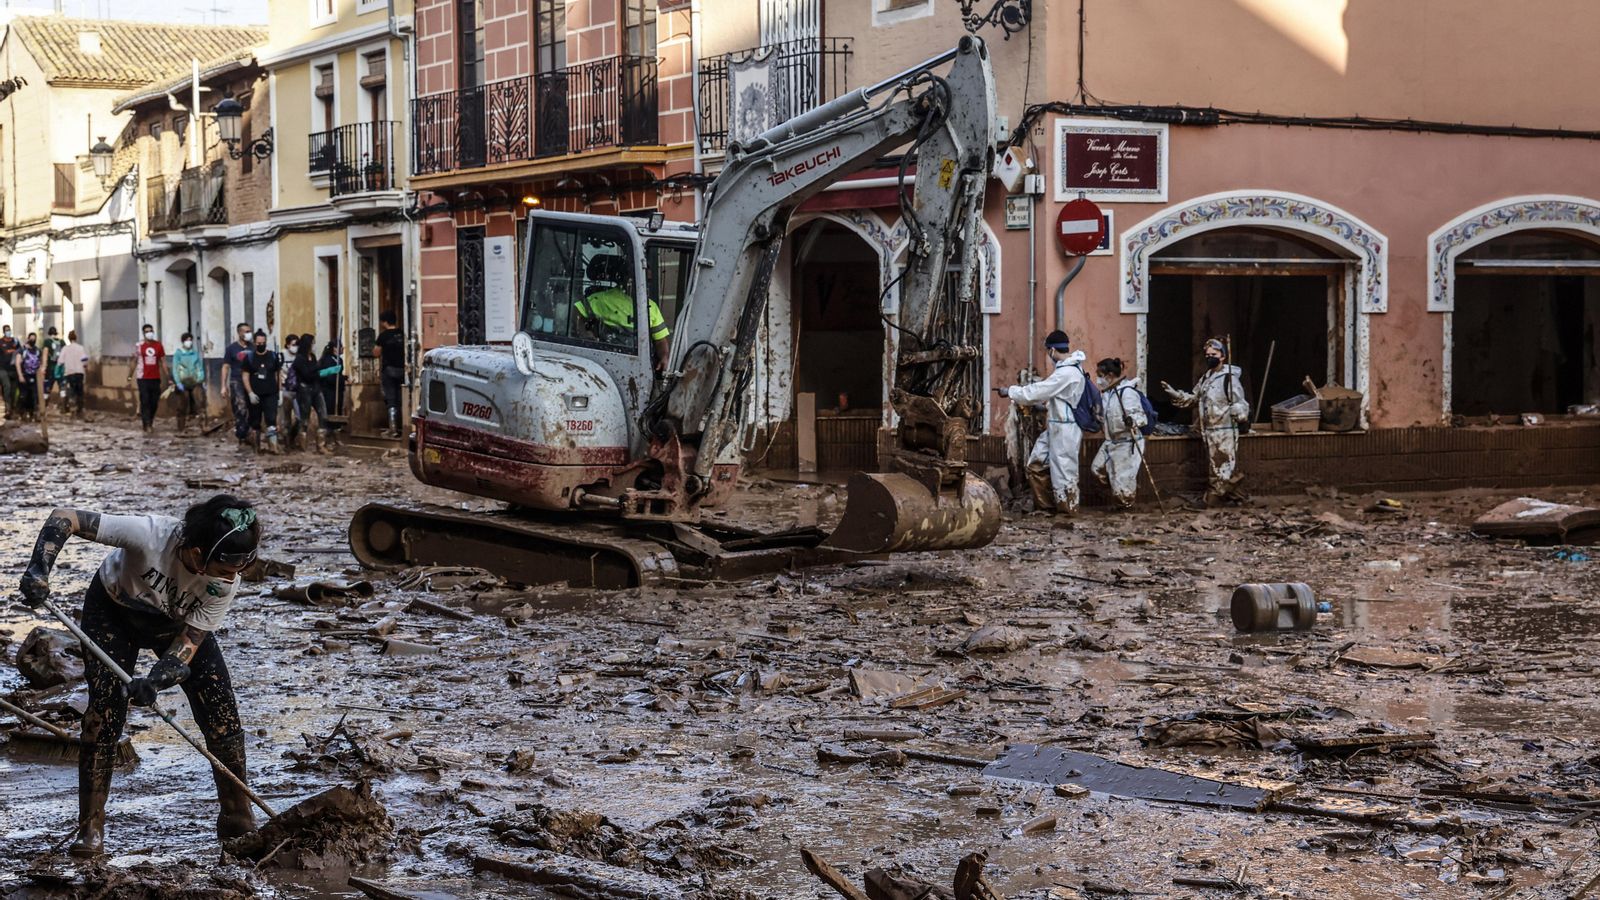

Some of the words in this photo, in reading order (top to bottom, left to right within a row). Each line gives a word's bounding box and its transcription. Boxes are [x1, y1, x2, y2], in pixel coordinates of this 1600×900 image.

[1086, 138, 1111, 151] Vicente
[1112, 140, 1141, 152] Moreno
[1083, 162, 1108, 178] Josep
[462, 401, 493, 420] TB260
[566, 419, 593, 431] TB260
